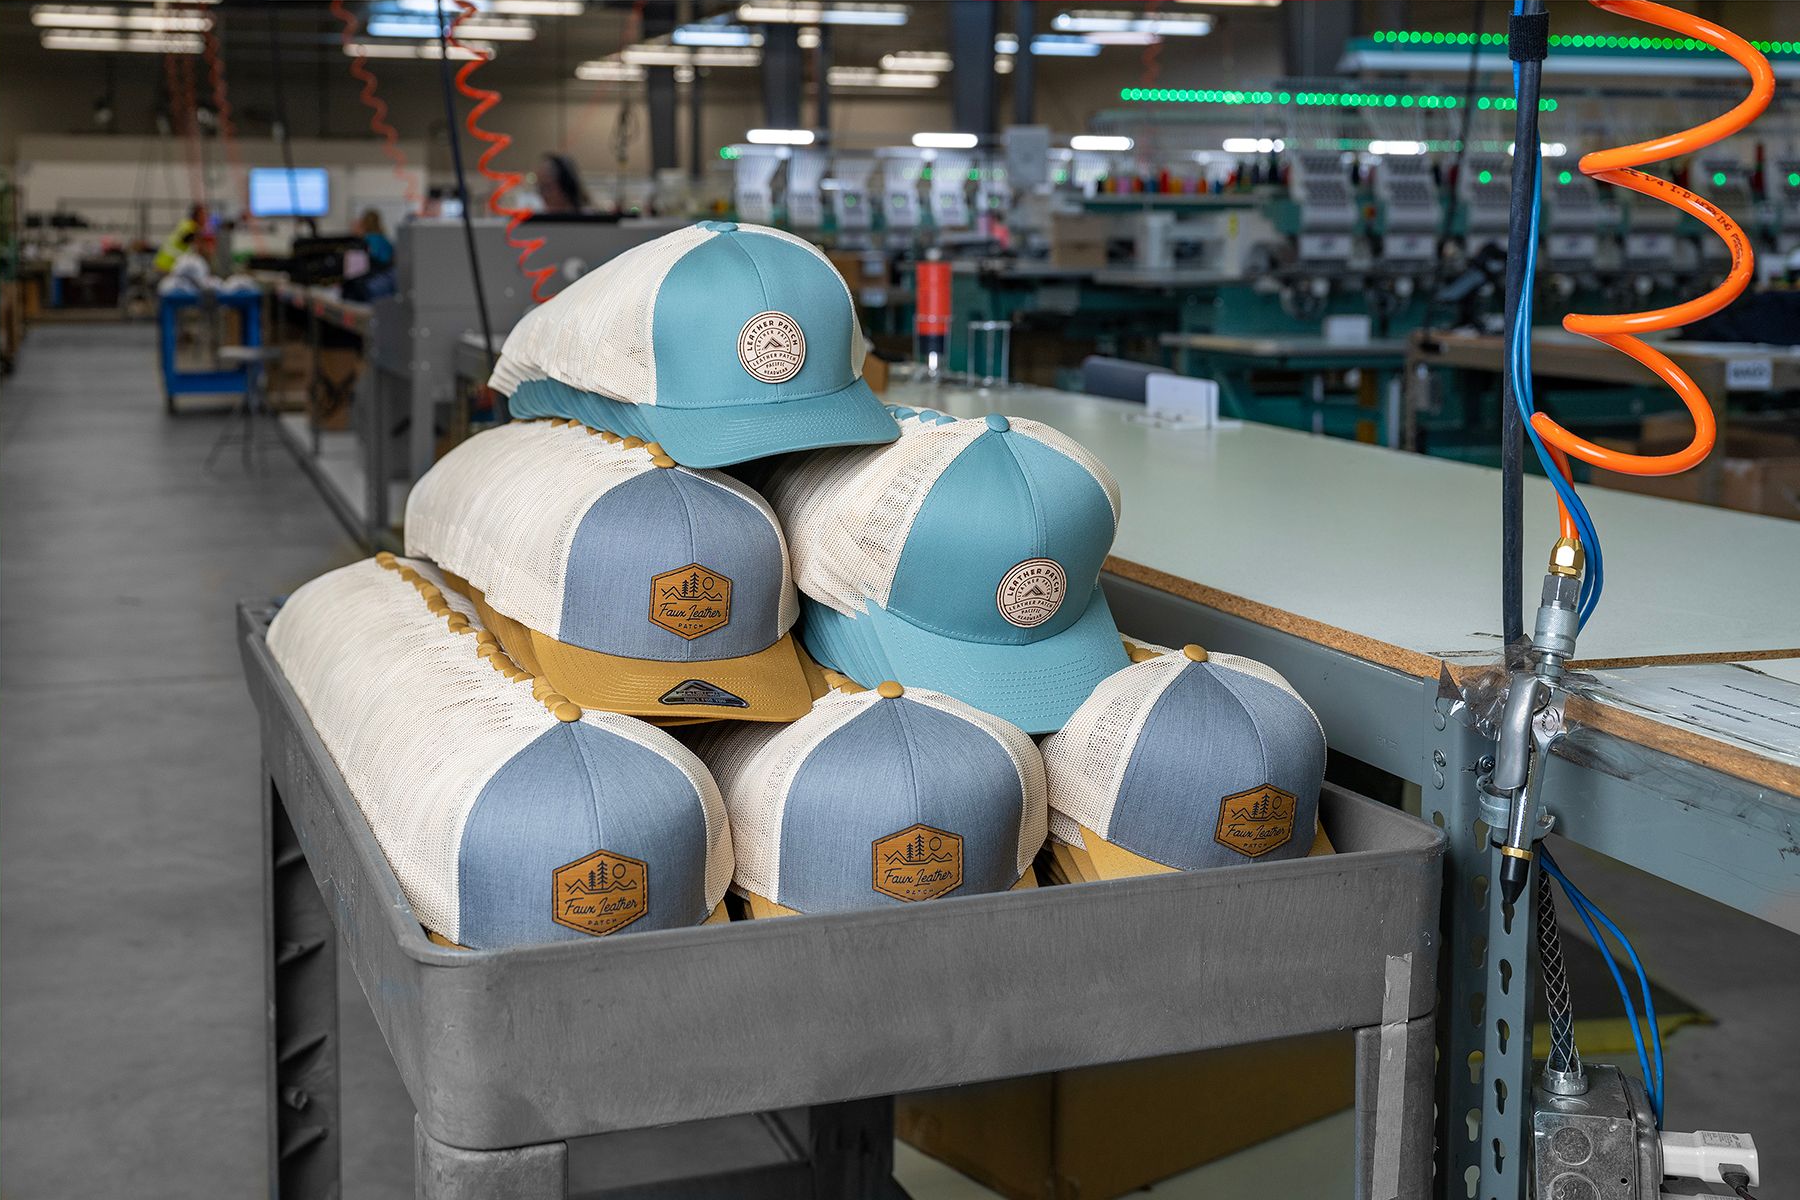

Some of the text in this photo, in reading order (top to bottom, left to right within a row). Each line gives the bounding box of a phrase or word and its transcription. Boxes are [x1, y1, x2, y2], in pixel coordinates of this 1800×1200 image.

[1695, 199, 1733, 232] WORKING
[747, 320, 798, 351] LEATHER PATCH
[753, 353, 796, 366] LEATHER PATCH
[1007, 568, 1059, 596] LEATHER PATCH
[659, 602, 721, 621] Faux Leather
[1009, 600, 1053, 611] LEATHER PATCH
[1226, 824, 1284, 840] Faux Leather
[884, 868, 953, 887] Faux Leather
[565, 897, 637, 917] Faux Leather
